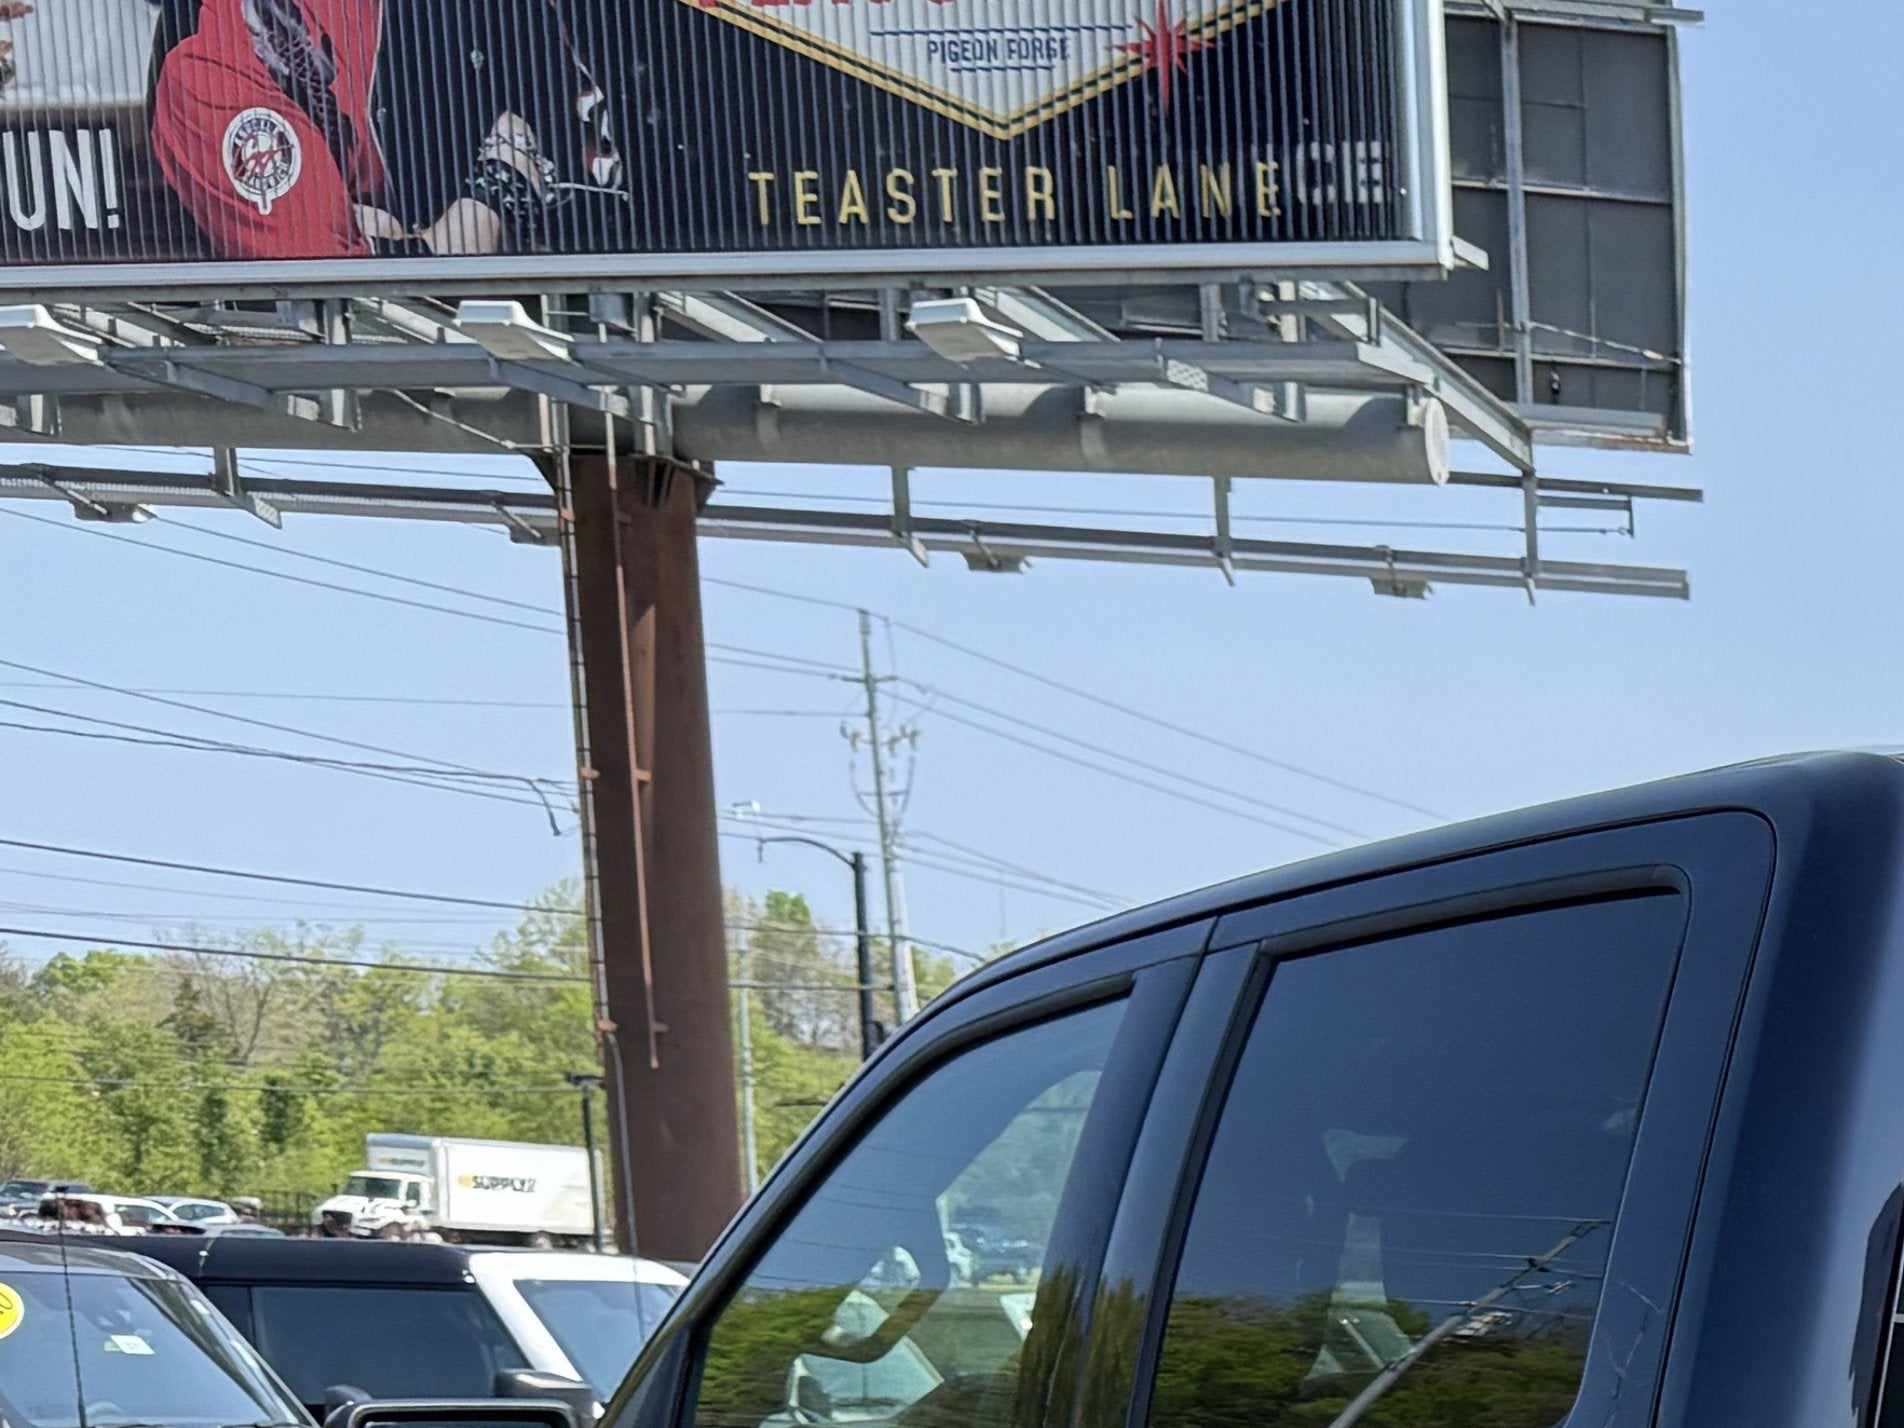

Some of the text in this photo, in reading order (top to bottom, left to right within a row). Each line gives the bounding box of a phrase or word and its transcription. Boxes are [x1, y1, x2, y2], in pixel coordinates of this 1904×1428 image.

[927, 36, 1069, 63] PIGEON FORGE
[748, 160, 1281, 224] TEASTER LANE
